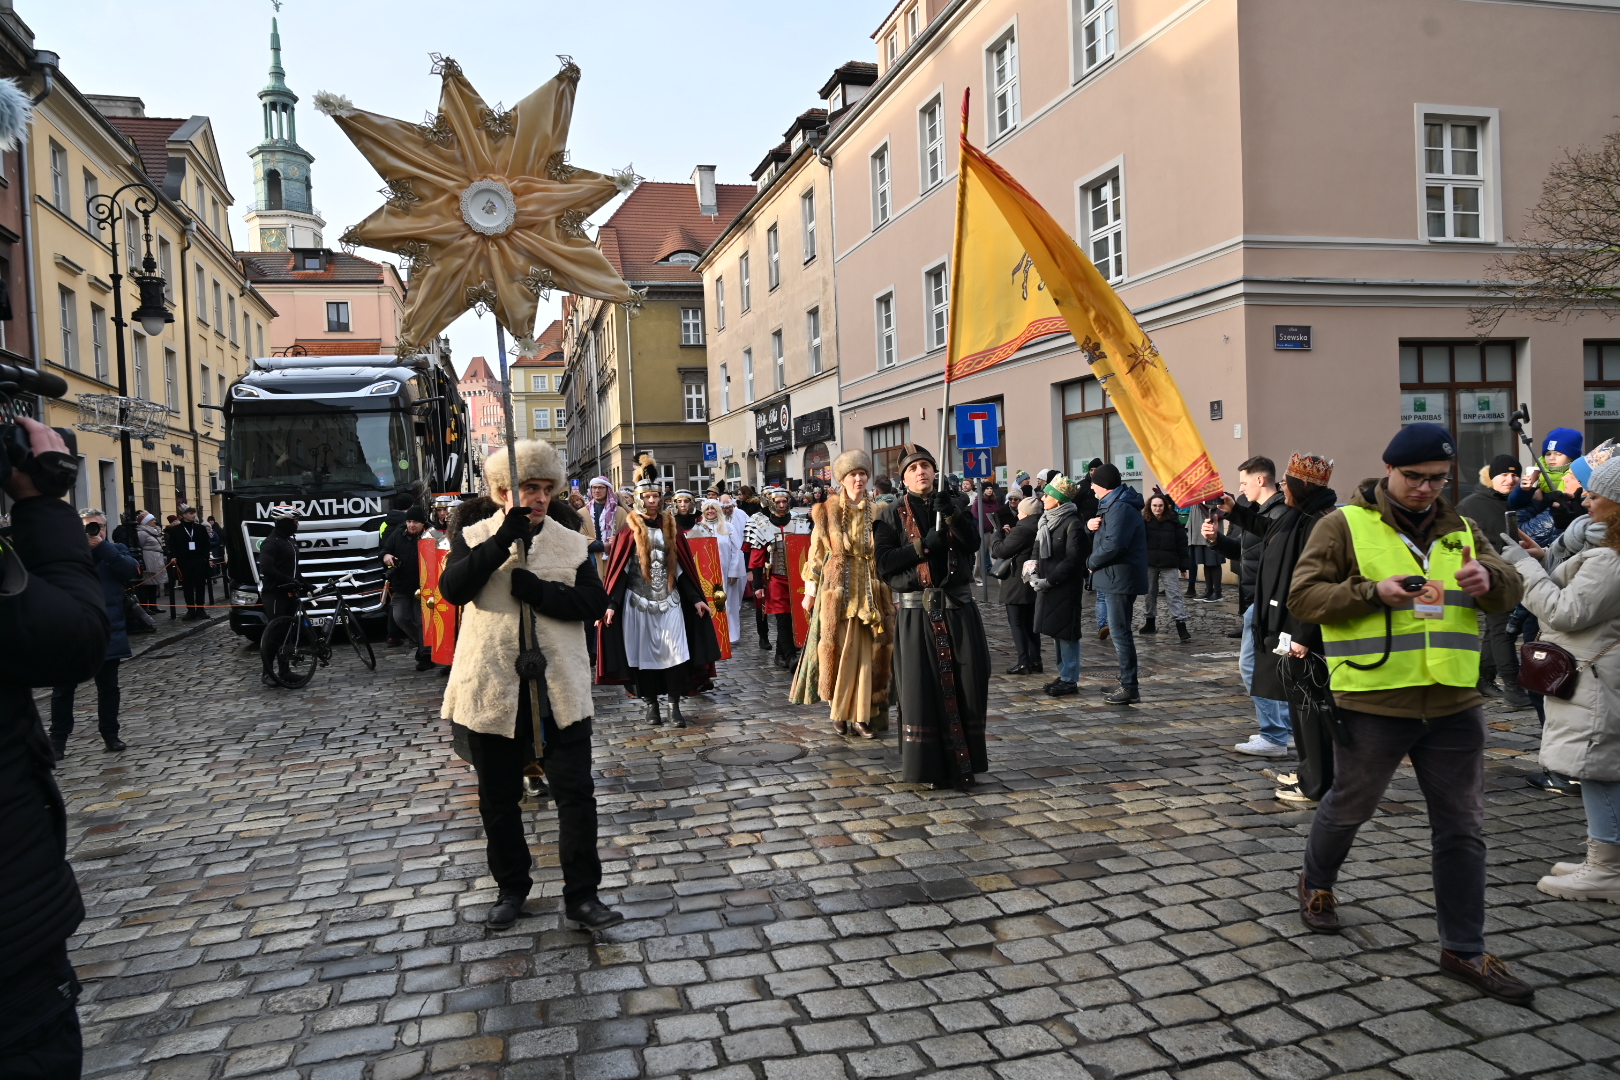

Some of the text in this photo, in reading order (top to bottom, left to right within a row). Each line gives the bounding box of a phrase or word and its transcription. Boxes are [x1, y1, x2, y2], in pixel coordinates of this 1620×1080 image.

[1279, 333, 1308, 341] Szewska
[706, 444, 715, 455] P
[256, 497, 382, 519] MRATHON
[298, 537, 349, 549] DAF
